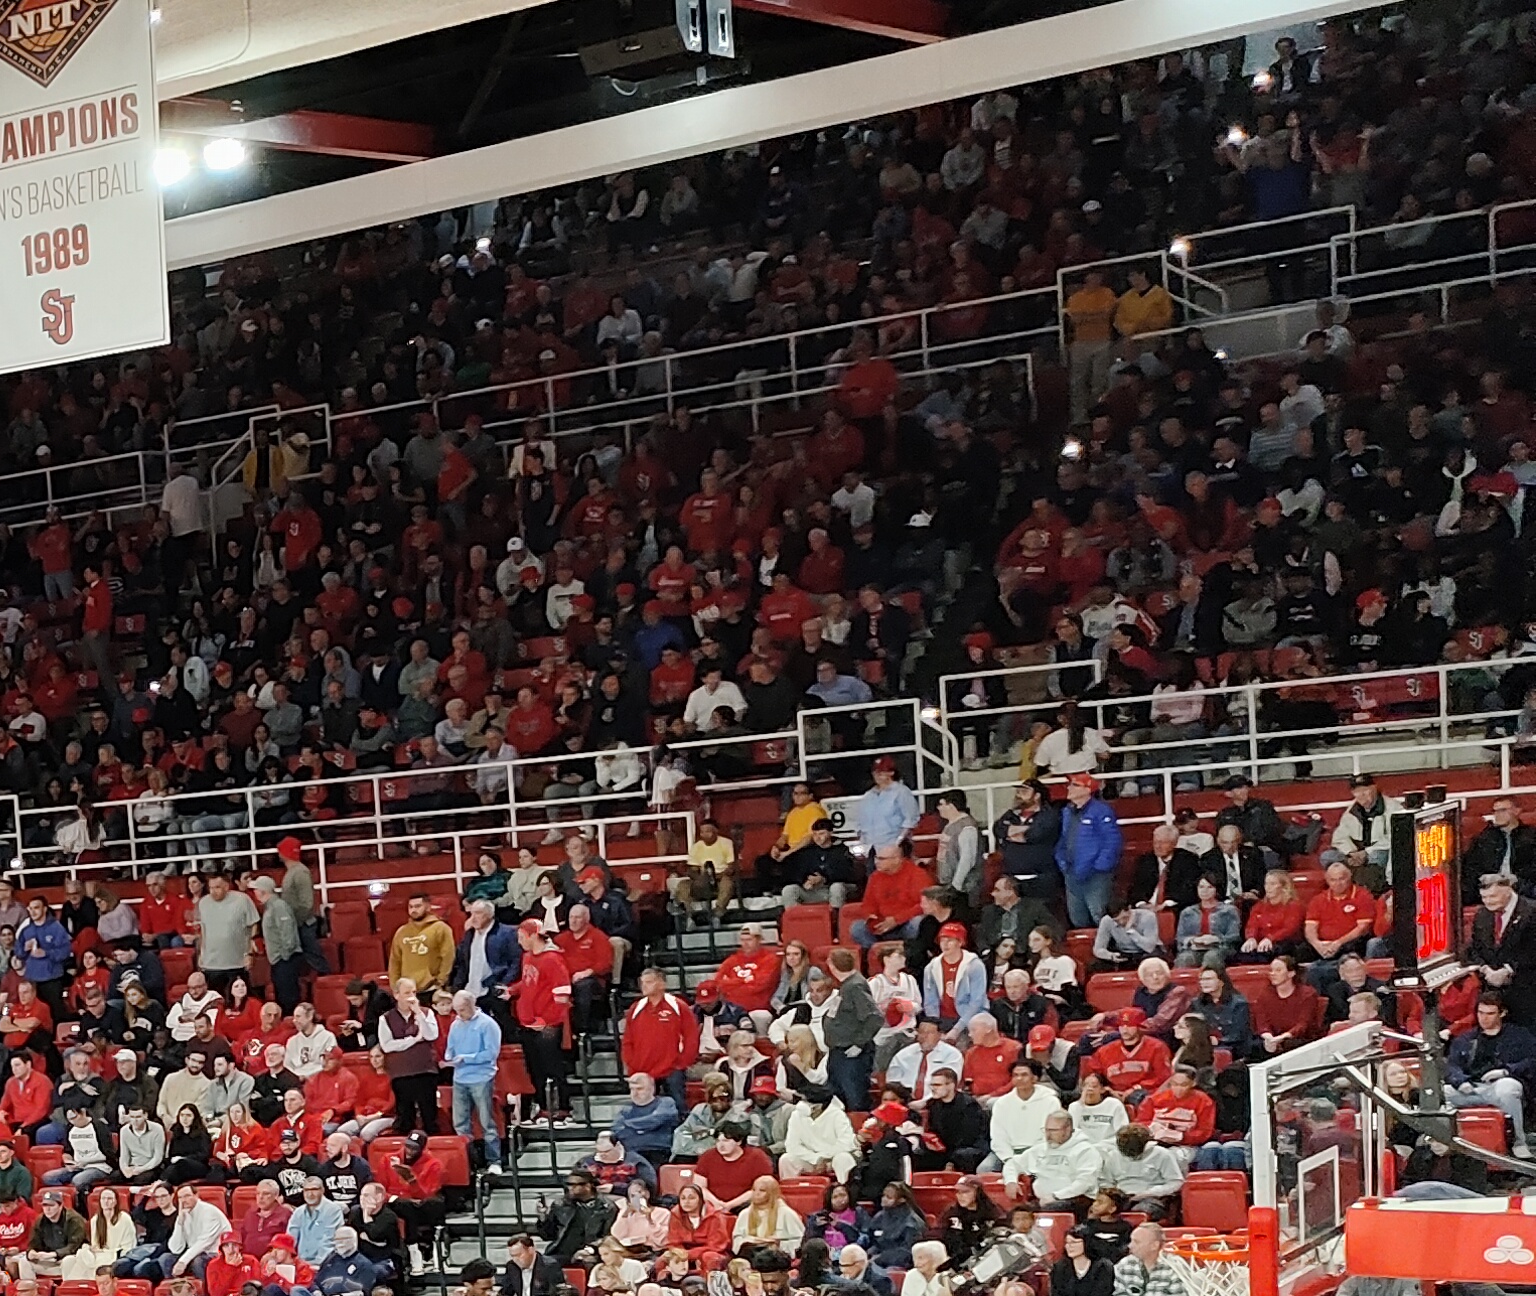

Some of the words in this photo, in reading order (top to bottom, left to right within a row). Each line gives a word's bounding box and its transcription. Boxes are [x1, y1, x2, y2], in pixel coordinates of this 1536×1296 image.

[5, 0, 82, 43] NIT
[25, 158, 144, 217] BASKETBALL
[20, 223, 91, 277] 1989
[831, 811, 846, 829] 9
